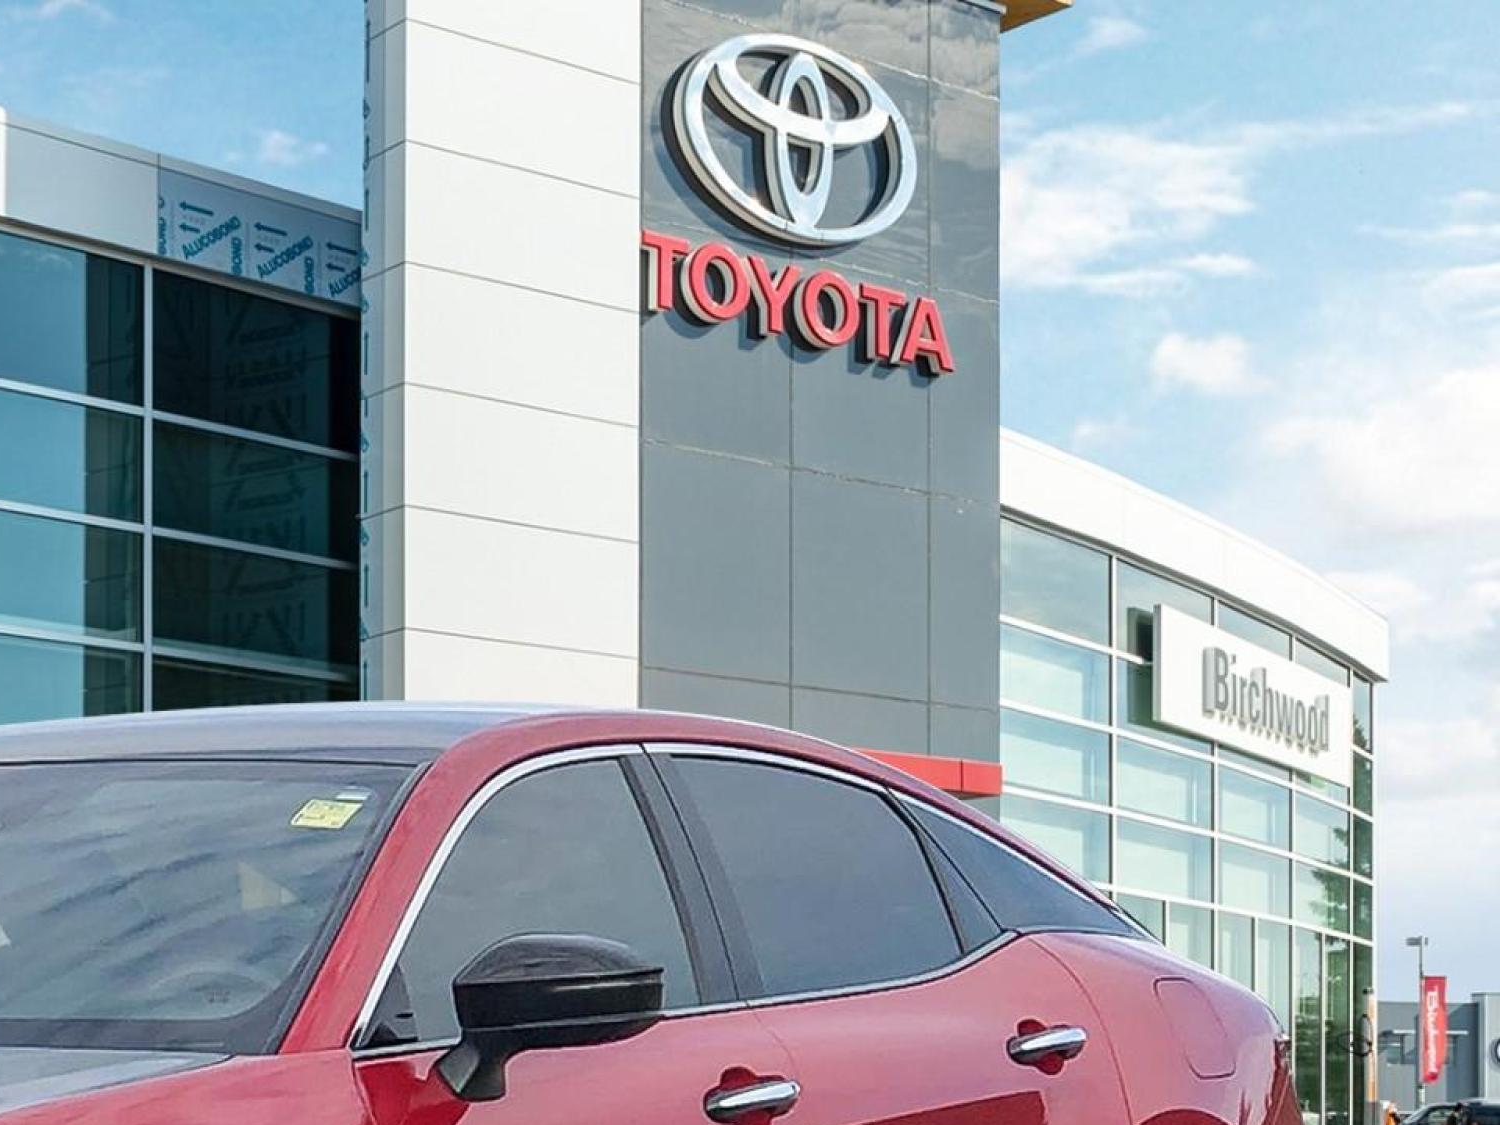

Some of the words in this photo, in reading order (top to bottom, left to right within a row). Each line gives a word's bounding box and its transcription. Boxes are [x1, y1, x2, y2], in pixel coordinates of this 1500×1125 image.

[182, 216, 241, 259] ALUCOBOND
[257, 236, 314, 280] ALUCOBOND
[642, 230, 955, 373] TOYOTA
[1204, 646, 1330, 754] Birchwood
